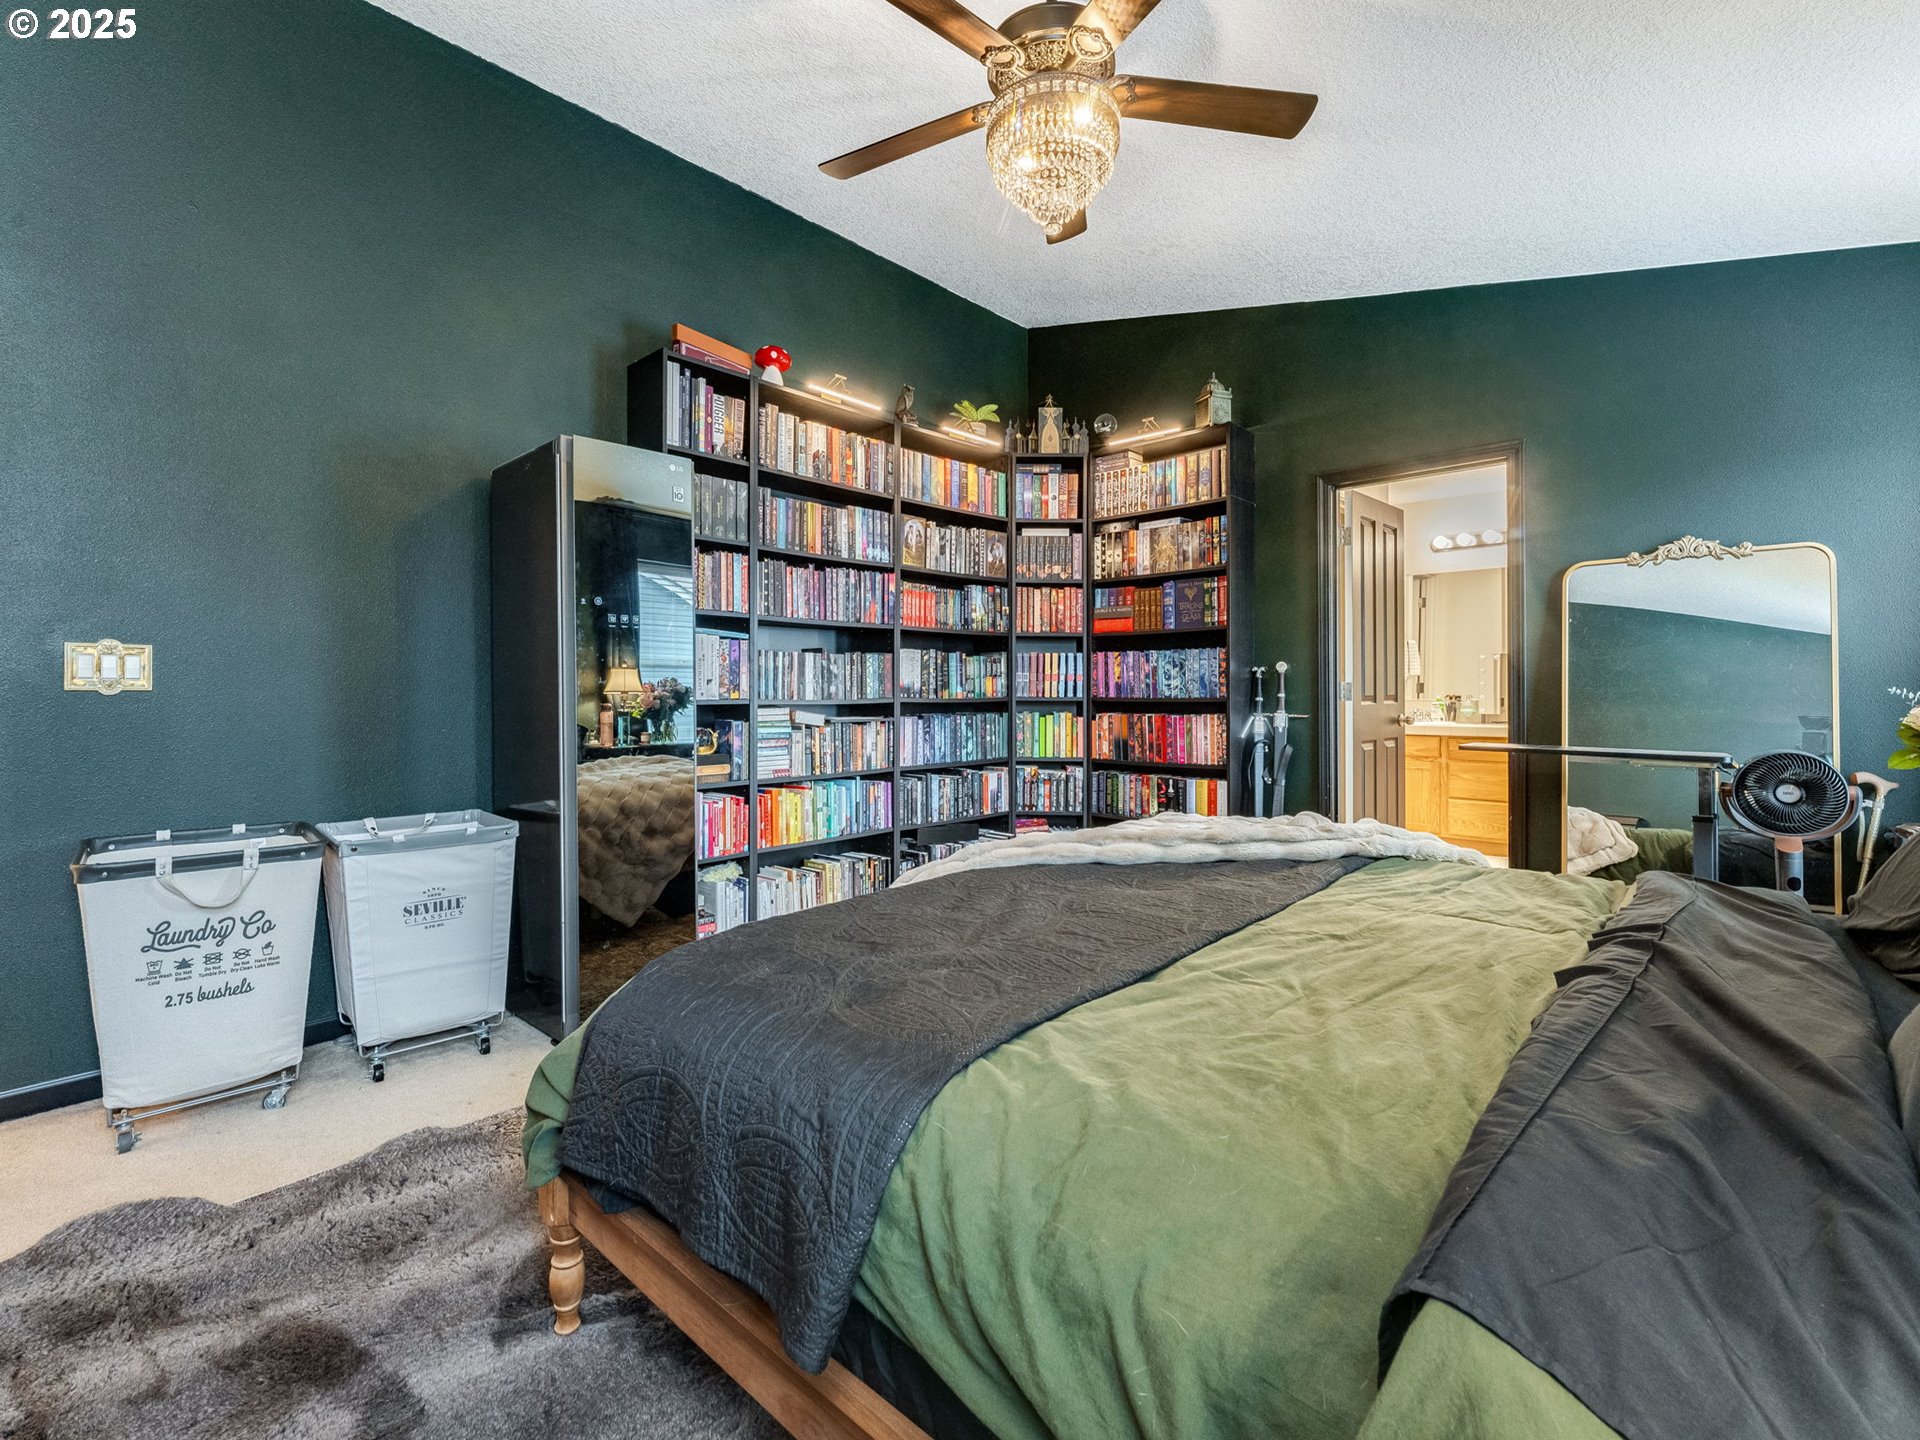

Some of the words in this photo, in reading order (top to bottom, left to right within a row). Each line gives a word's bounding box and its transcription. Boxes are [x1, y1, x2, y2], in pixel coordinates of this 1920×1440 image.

[713, 399, 725, 435] DIGGER
[403, 897, 464, 918] SEVILLE
[405, 909, 464, 925] CLASSICS
[141, 914, 237, 953] Laundry
[240, 910, 276, 940] Co
[164, 991, 194, 1008] 2.75
[196, 977, 256, 1003] bushels
